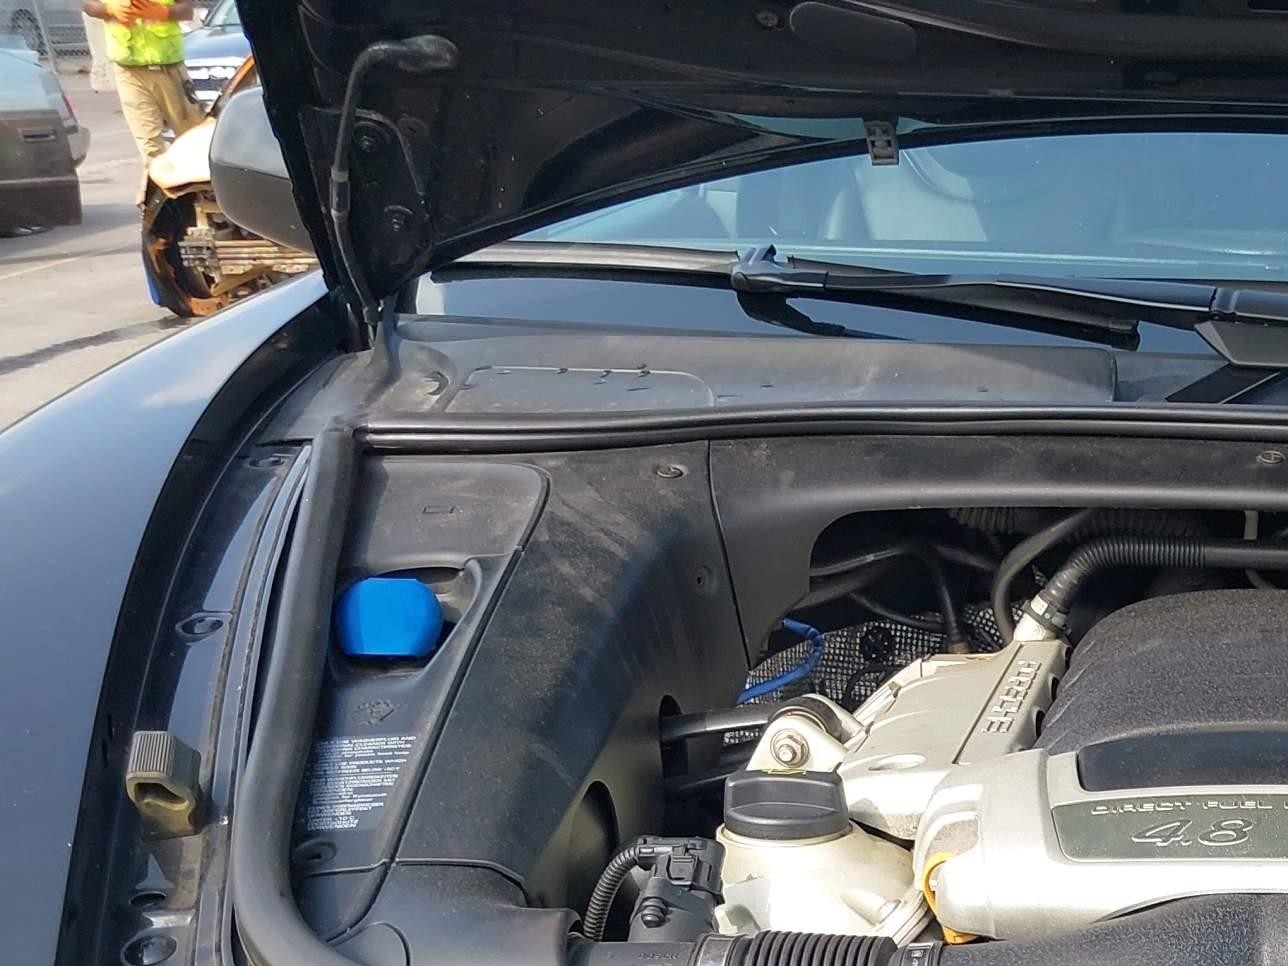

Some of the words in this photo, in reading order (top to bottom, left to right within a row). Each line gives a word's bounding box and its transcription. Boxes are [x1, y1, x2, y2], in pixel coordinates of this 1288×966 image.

[1091, 801, 1190, 816] DIRECT
[1201, 800, 1274, 810] FUEL
[1131, 818, 1254, 848] 4.8
